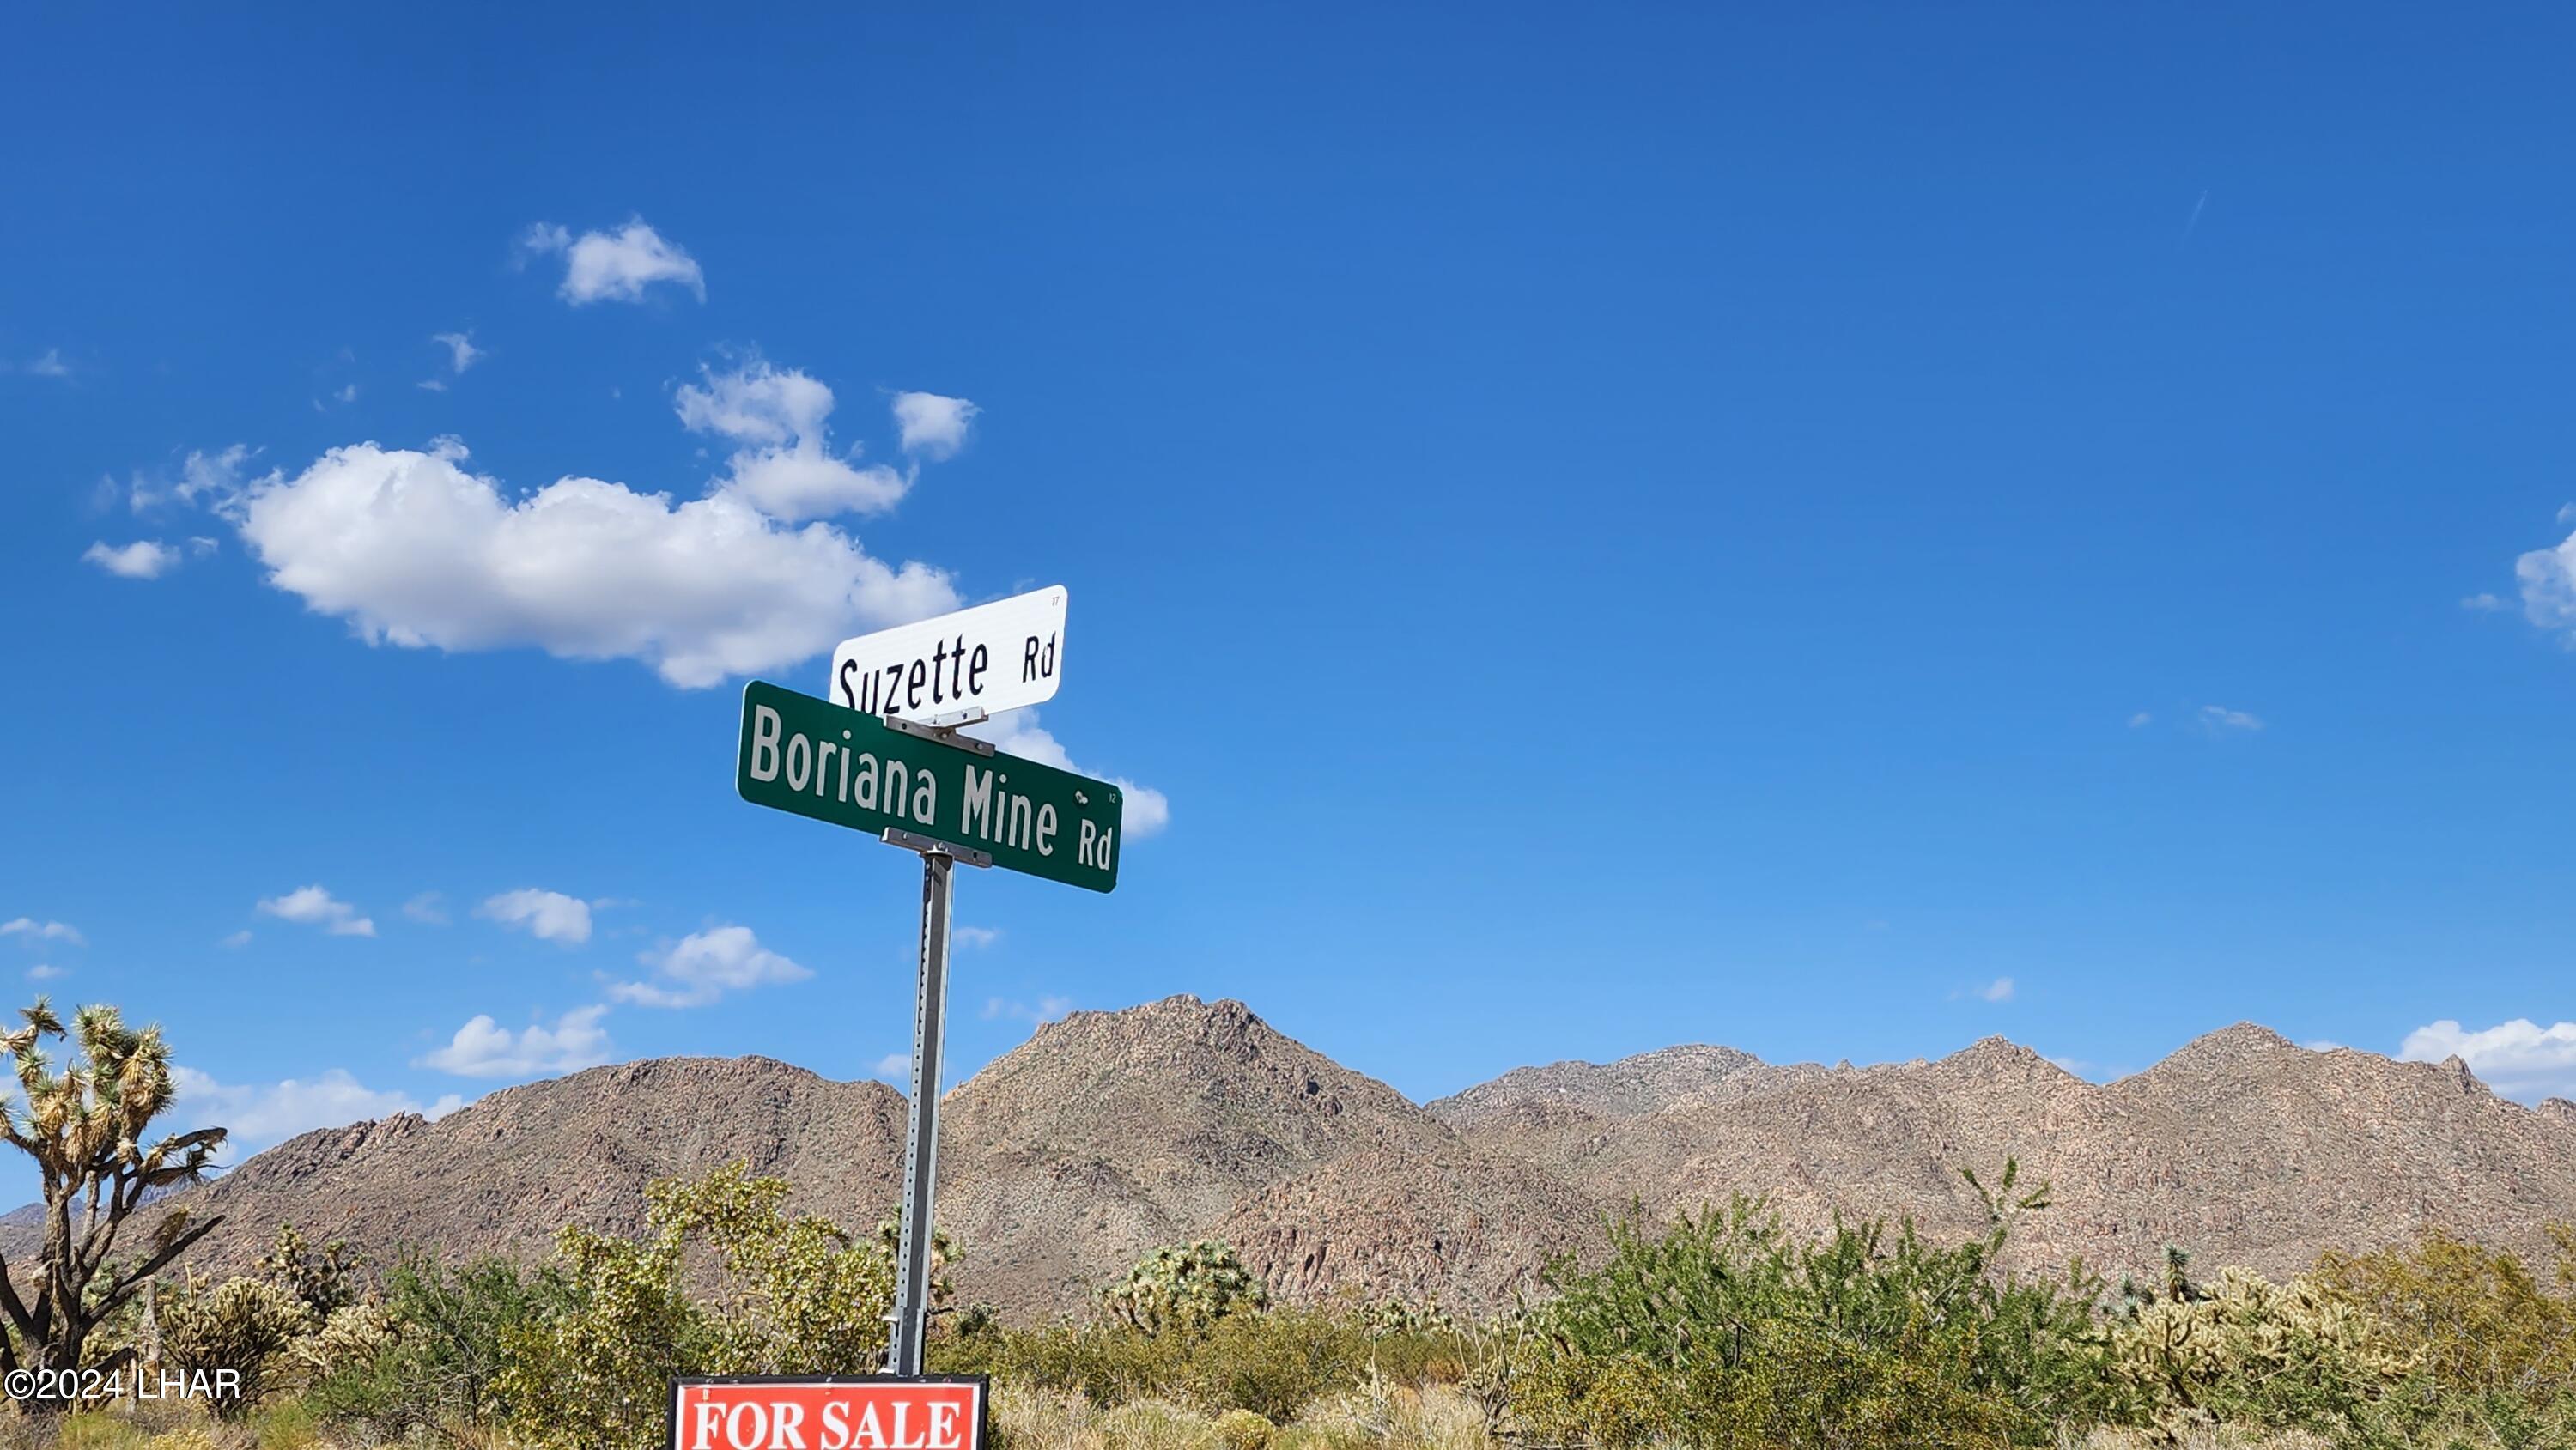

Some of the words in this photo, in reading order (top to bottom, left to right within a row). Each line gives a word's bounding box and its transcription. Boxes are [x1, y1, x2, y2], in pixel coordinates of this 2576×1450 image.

[839, 634, 988, 715] Suzette
[1022, 630, 1057, 684] Rd
[750, 704, 937, 826] Boriana
[961, 764, 1058, 857] Mine
[1078, 819, 1113, 871] Rd
[1109, 792, 1116, 804] 12
[691, 1400, 807, 1450] FOR
[820, 1400, 962, 1450] SALE
